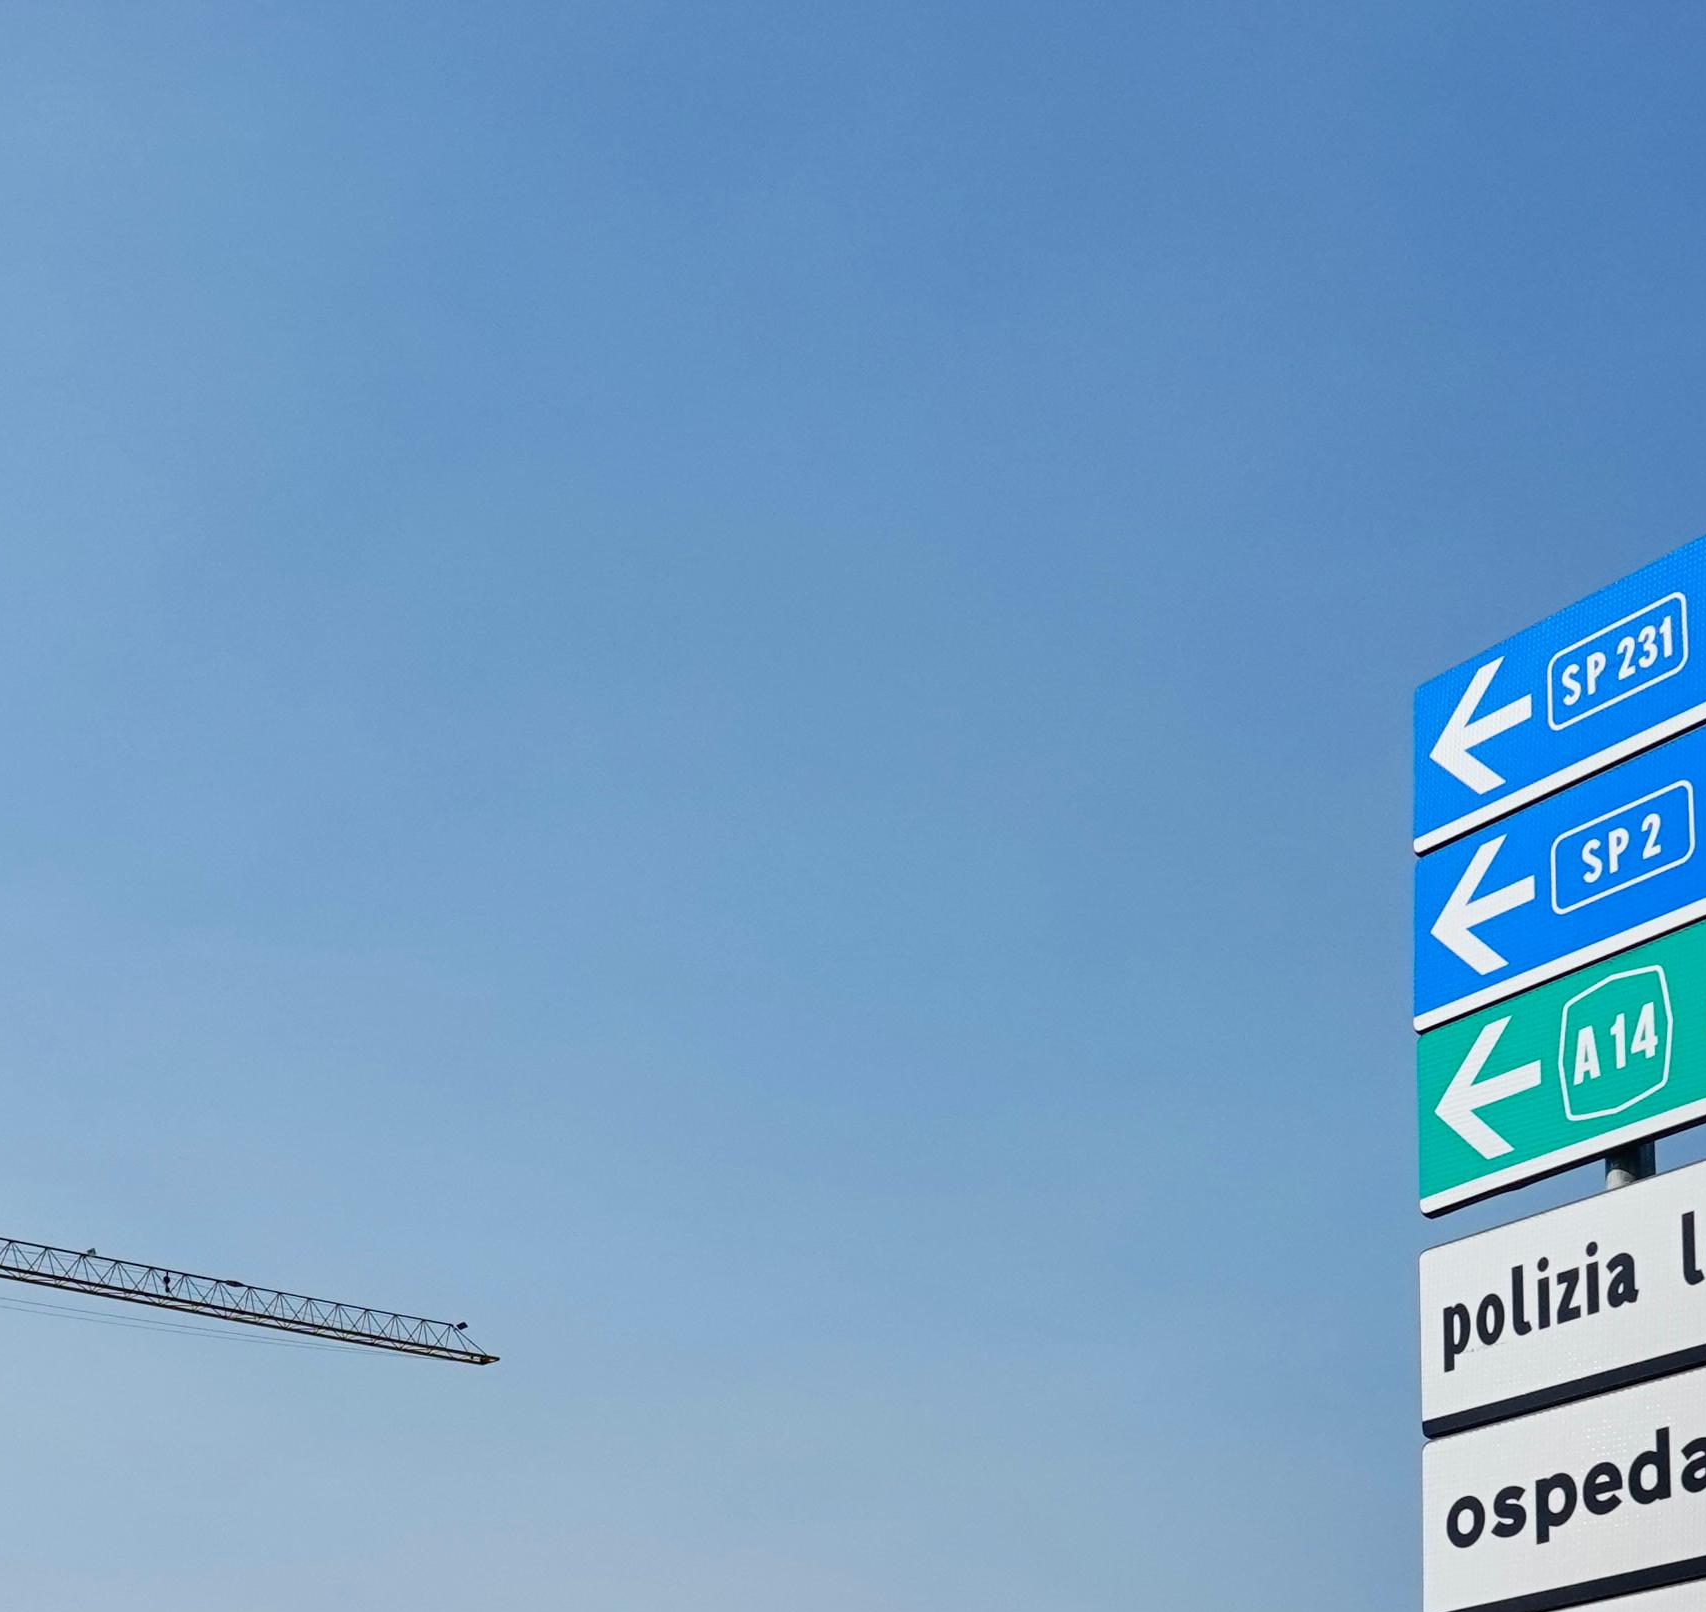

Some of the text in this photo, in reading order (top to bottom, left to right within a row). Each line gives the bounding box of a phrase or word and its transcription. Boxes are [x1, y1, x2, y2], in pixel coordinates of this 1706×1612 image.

[1561, 615, 1674, 707] SP 231
[1581, 812, 1662, 884] SP 2
[1572, 1000, 1659, 1086] A 14
[1442, 1240, 1640, 1374] polizia
